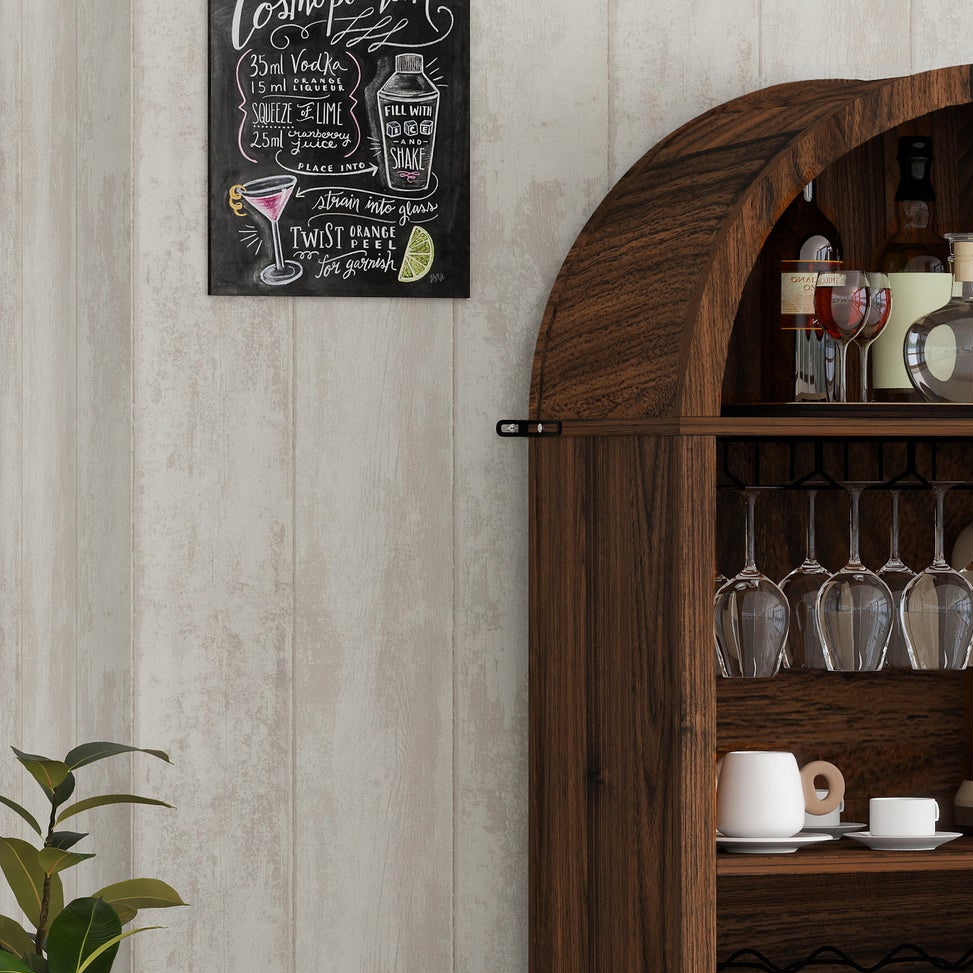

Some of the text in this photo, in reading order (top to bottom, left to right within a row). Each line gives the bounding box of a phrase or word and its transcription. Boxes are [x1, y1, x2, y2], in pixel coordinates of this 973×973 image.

[250, 54, 284, 77] 35ml
[252, 102, 293, 125] SQUEEZE
[316, 102, 344, 126] LIME
[384, 105, 432, 117] FILL WITH
[250, 129, 352, 148] 25ml cranberry
[291, 138, 338, 156] juice
[297, 162, 366, 172] PLACE INTO
[390, 147, 426, 171] SHAKE
[312, 191, 439, 226] strain into glass
[290, 222, 396, 249] TWIST ORANGE
[351, 240, 396, 250] PEEL
[315, 251, 398, 279] for garnish
